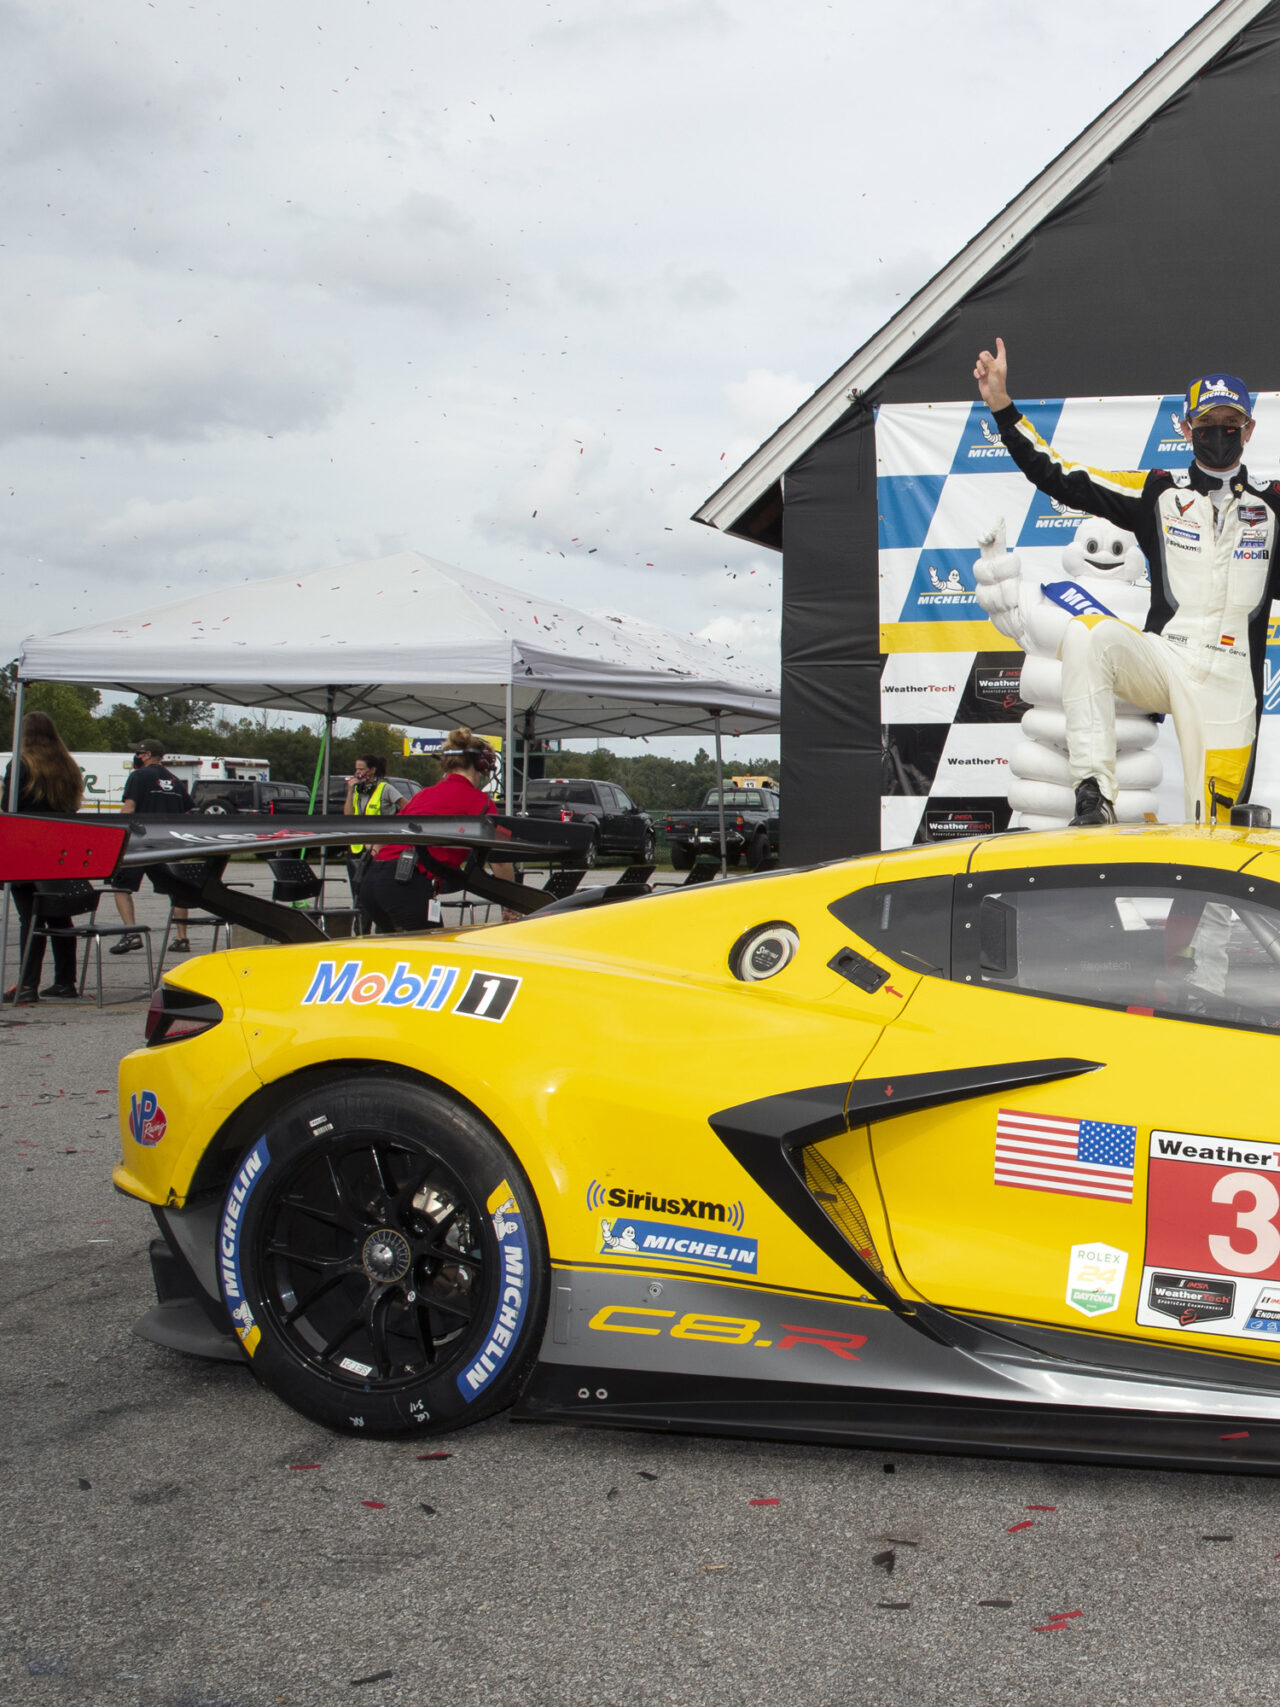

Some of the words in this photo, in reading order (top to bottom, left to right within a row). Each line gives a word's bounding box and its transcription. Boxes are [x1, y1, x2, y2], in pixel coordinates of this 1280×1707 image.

[885, 685, 956, 693] WeatherTech
[302, 961, 460, 1011] Mobil
[221, 1150, 262, 1297] MICHELIN
[1208, 1172, 1280, 1273] 3
[642, 1234, 755, 1264] MICHELIN
[1078, 1250, 1120, 1263] ROLEX
[1077, 1265, 1118, 1284] 24
[1154, 1288, 1229, 1303] WeatherTech
[466, 1245, 524, 1390] MICHELIN
[588, 1304, 869, 1361] C8.R
